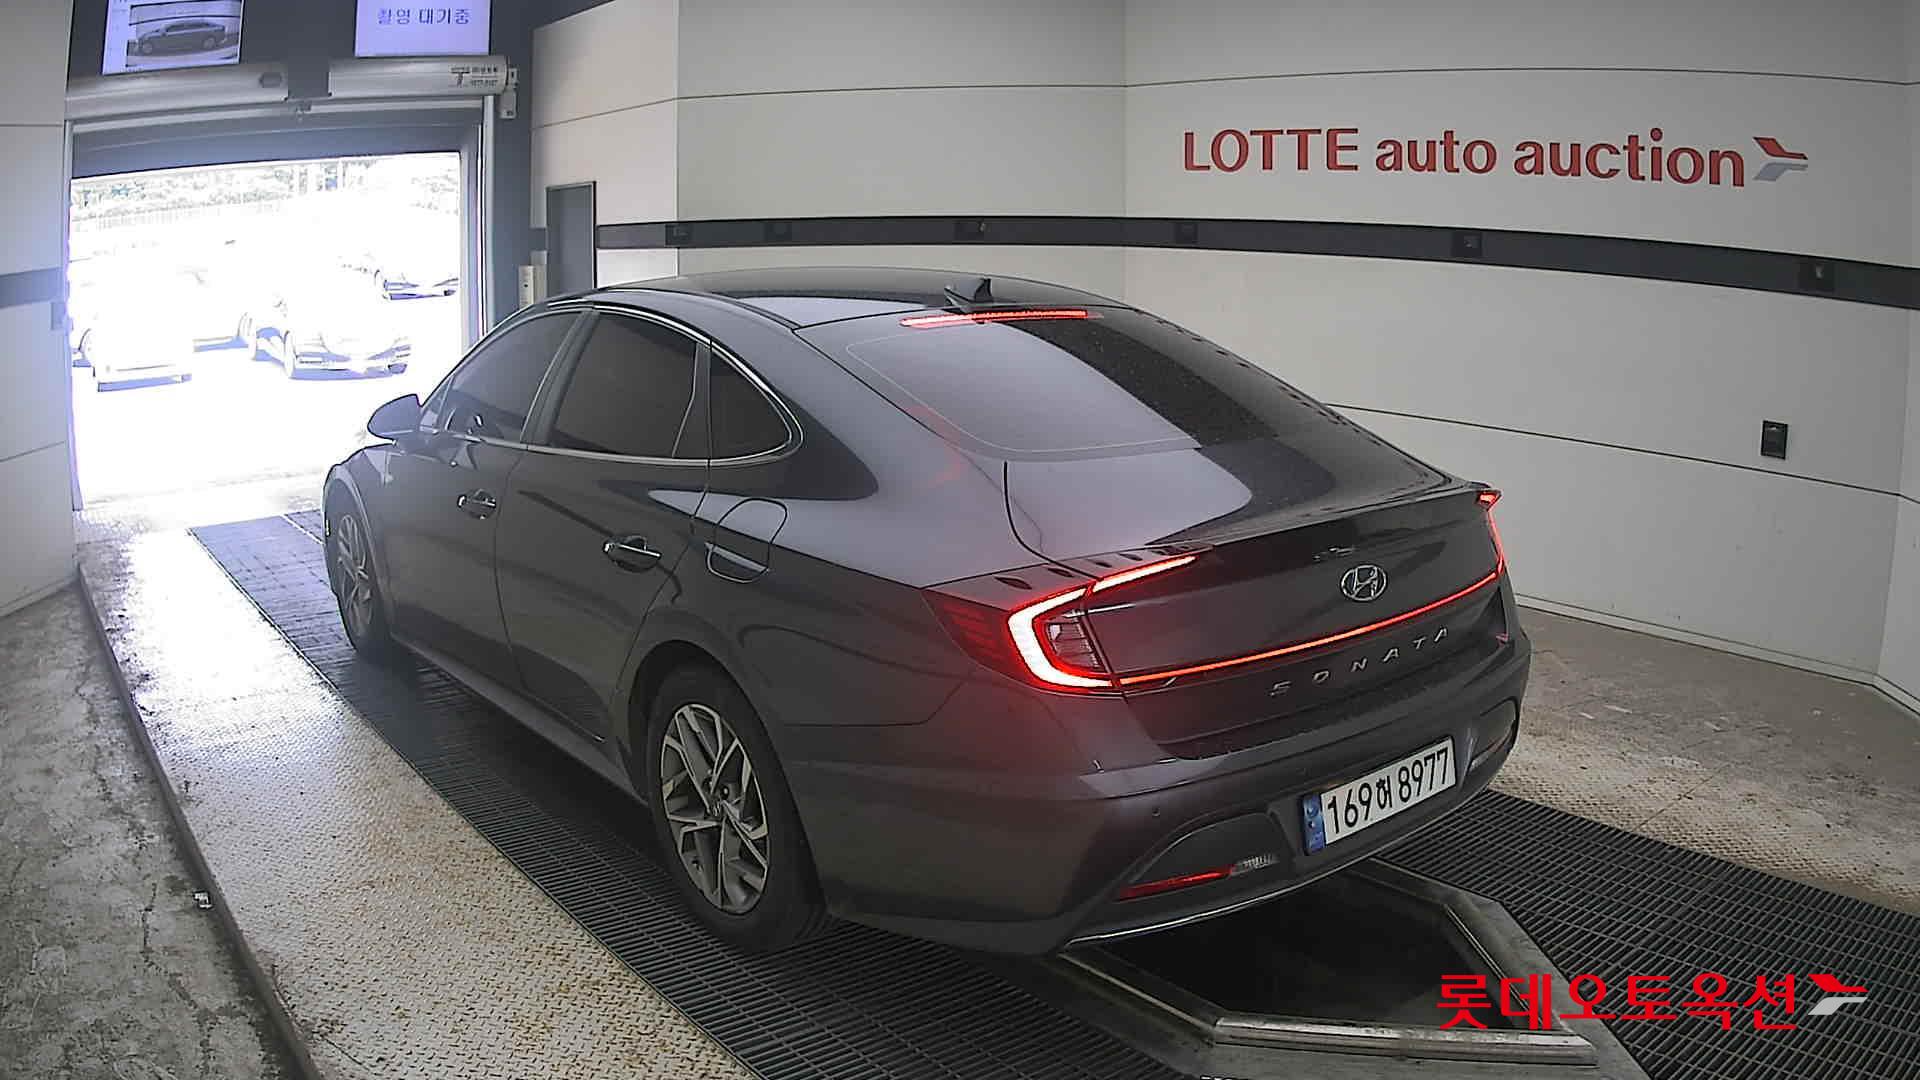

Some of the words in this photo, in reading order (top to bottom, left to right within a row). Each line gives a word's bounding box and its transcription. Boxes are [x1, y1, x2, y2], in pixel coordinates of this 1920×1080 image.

[418, 8, 470, 25] 대기중
[1184, 128, 1358, 172] LOTTE
[1375, 130, 1497, 174] auto
[1514, 128, 1744, 187] auction
[1269, 627, 1448, 696] SONATA
[1327, 775, 1393, 834] 169허
[1398, 747, 1449, 803] 8977
